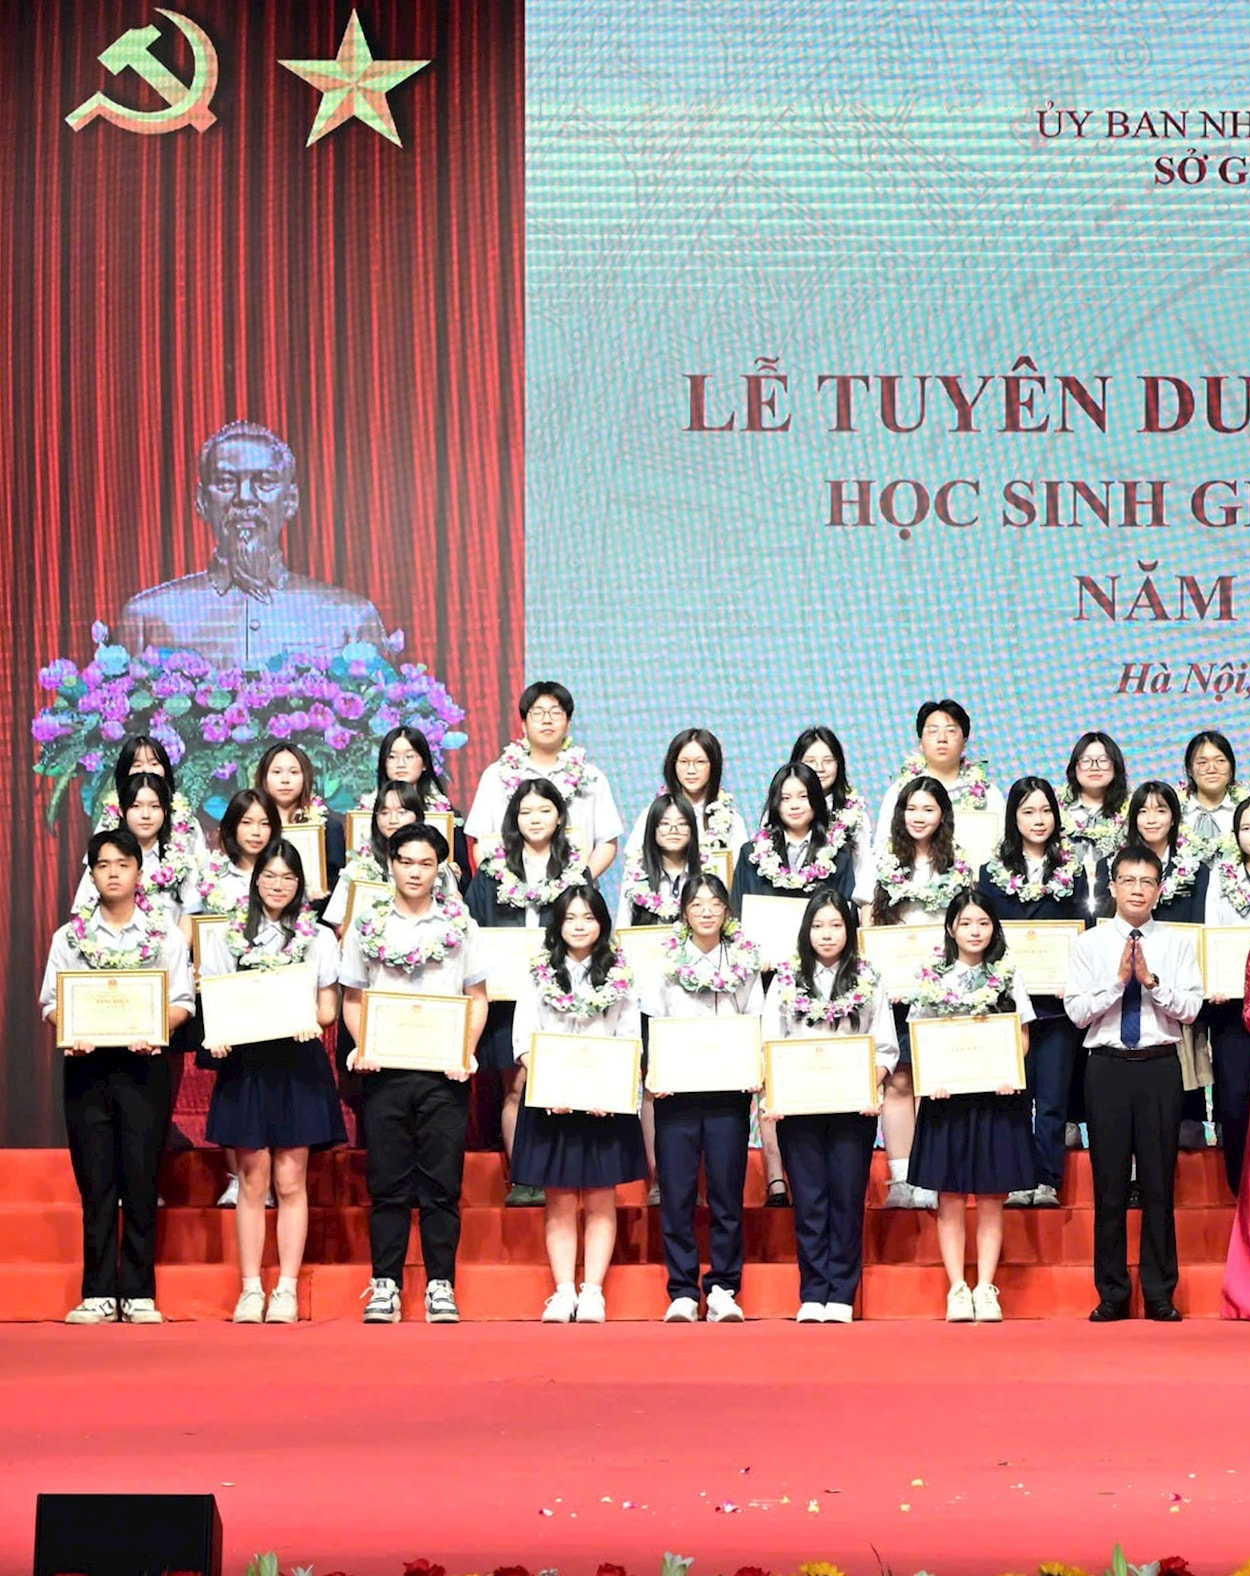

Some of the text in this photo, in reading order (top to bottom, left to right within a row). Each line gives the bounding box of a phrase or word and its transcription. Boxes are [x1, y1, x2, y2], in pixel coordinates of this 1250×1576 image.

[1036, 100, 1093, 139] ỦY
[1105, 110, 1190, 139] BAN
[1155, 148, 1209, 185] SỞ
[682, 356, 792, 433] LỄ
[817, 355, 1113, 433] TUYÊN
[824, 479, 981, 541] HỌC
[1003, 480, 1166, 527] SINH
[1073, 560, 1237, 622] NĂM
[1116, 662, 1171, 694] Hà
